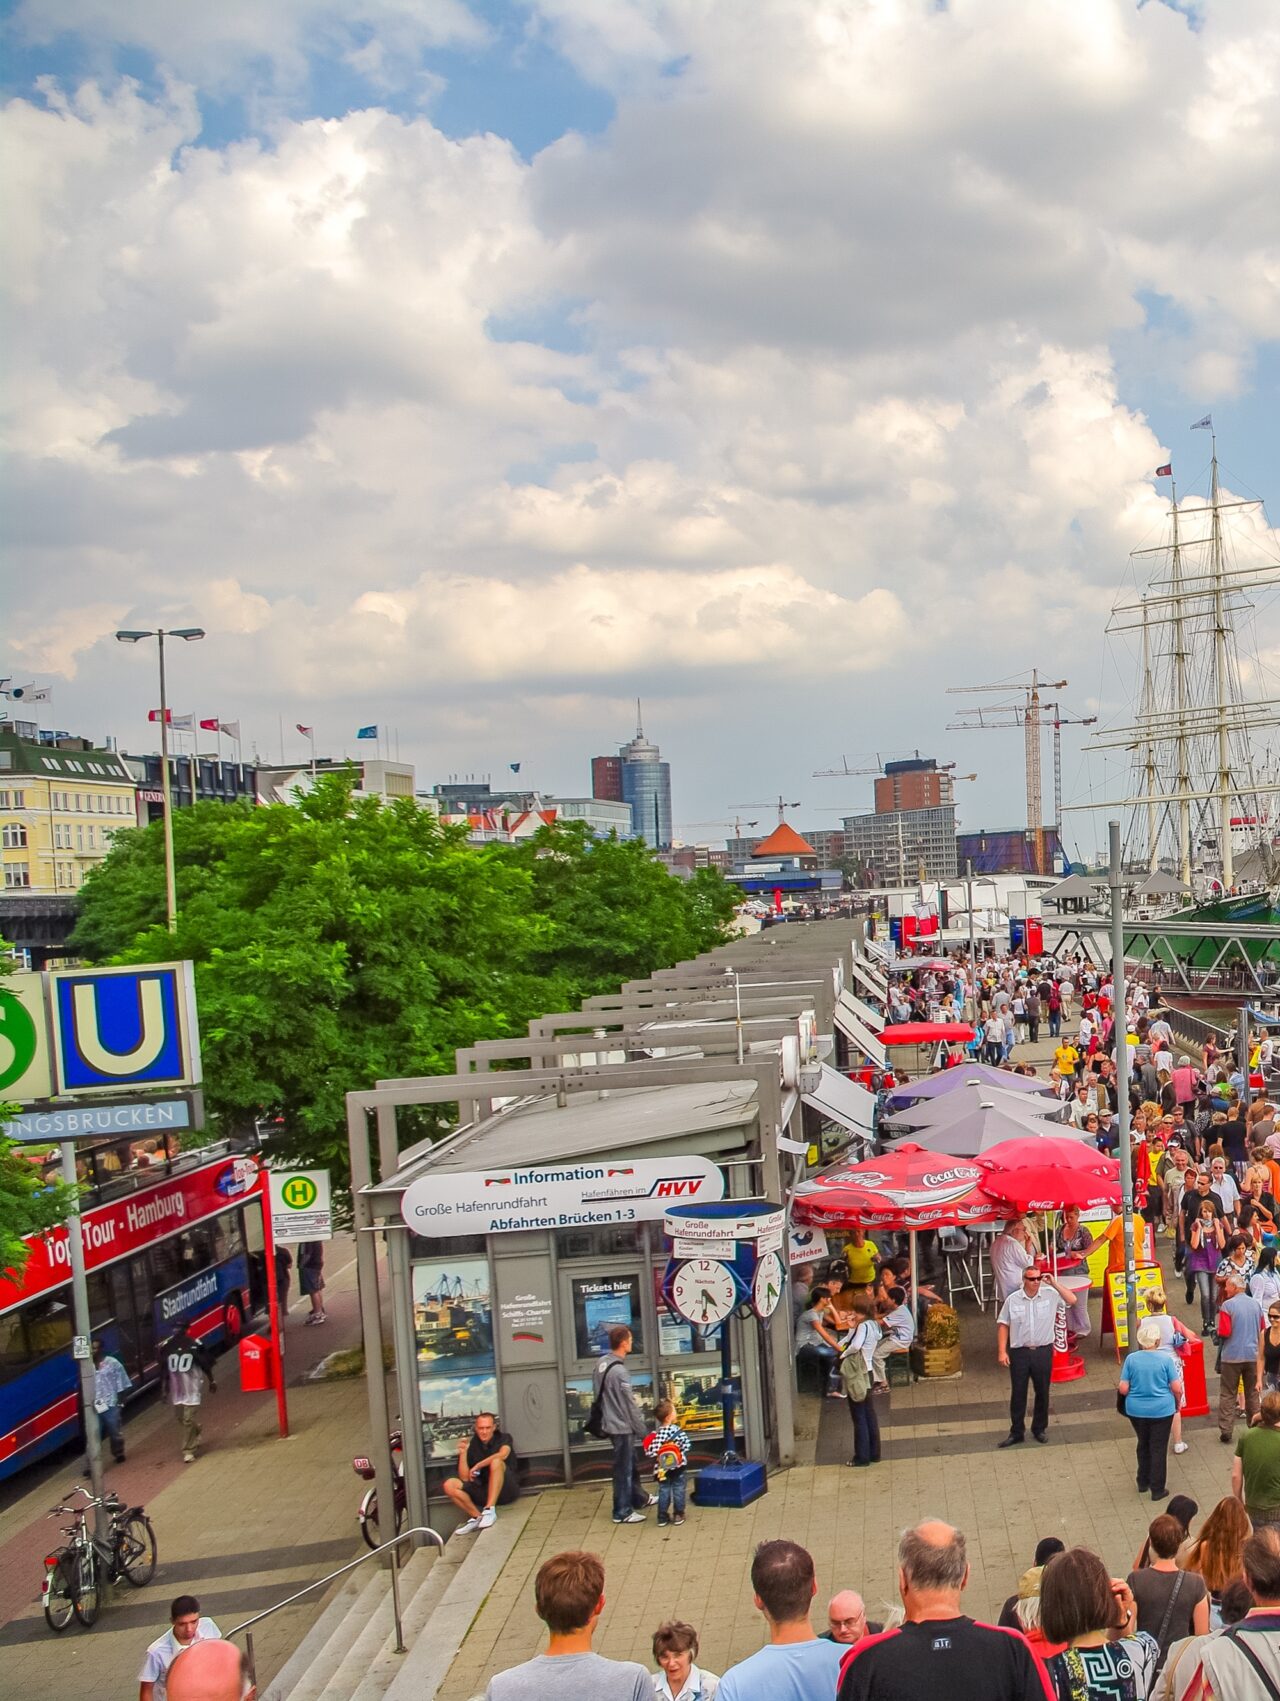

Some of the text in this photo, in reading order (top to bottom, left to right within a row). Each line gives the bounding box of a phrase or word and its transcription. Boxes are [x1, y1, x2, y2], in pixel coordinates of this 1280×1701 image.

[73, 979, 165, 1075] U
[514, 1166, 604, 1185] Information
[291, 1183, 308, 1202] H
[581, 1187, 633, 1198] Hafenfähren
[657, 1180, 703, 1196] HVV
[415, 1196, 548, 1216] Große Hafenrundfahrt
[969, 1204, 993, 1214] Coca-Cola
[1028, 1200, 1055, 1209] Coca-Cola
[127, 1191, 185, 1232] Hamburg
[918, 1209, 943, 1220] Coca-Cola
[490, 1209, 636, 1230] Abfahrten Brücken 1-3
[685, 1220, 709, 1229] Große
[674, 1228, 734, 1238] Hafenrundfahrt
[766, 1255, 773, 1265] 12
[698, 1261, 711, 1271] 12
[580, 1282, 632, 1293] Tickets hier
[676, 1287, 683, 1297] 9
[725, 1287, 733, 1297] 3
[162, 1273, 218, 1319] Stadtrundfahrt
[702, 1311, 709, 1321] 6
[168, 1353, 194, 1372] 00
